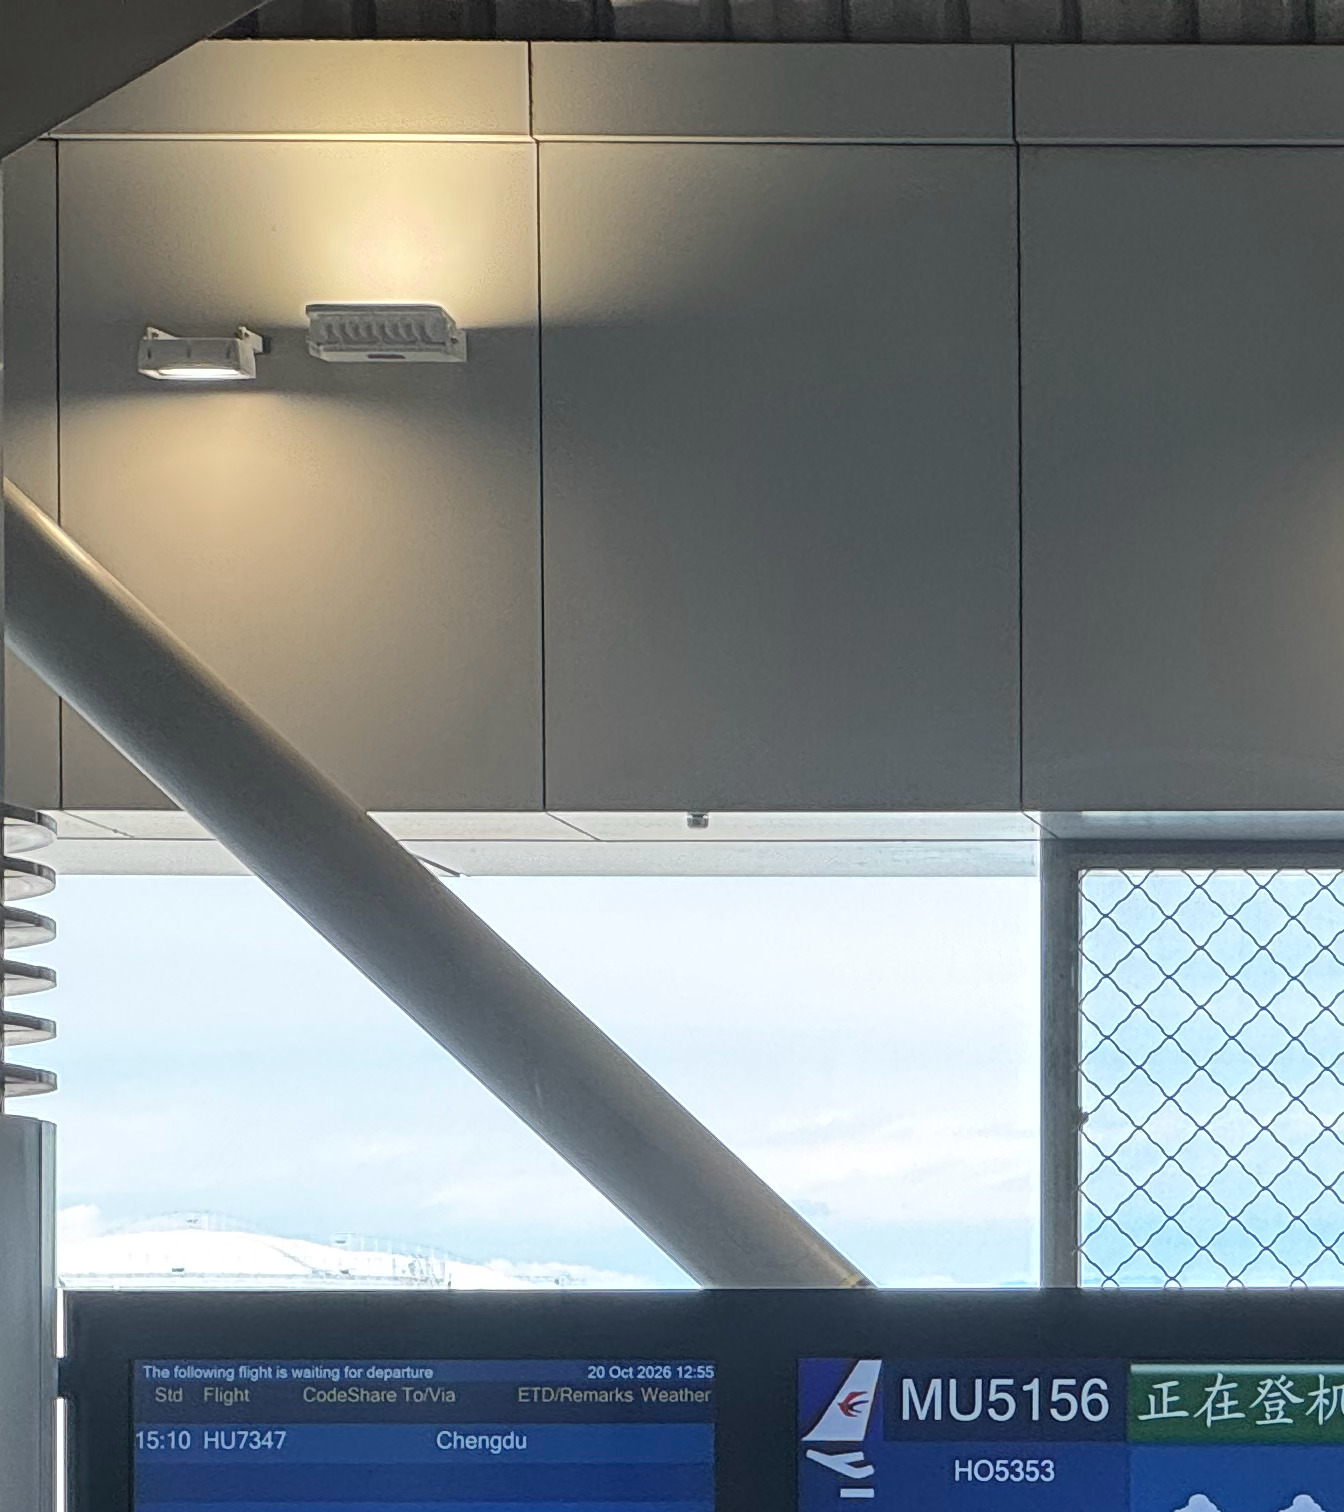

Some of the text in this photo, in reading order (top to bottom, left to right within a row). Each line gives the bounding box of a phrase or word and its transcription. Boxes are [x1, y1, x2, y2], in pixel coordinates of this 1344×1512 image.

[143, 1365, 433, 1381] The following flight is waiting for departure
[587, 1366, 715, 1379] 20 Oct 2026 12:55
[155, 1387, 711, 1406] Std Flight CodeShare To/Via ETD/Remarks Weather
[901, 1378, 1109, 1421] MU5156
[136, 1430, 527, 1454] 15:10 HU7347 Chengdu
[954, 1460, 1055, 1482] HO5353
